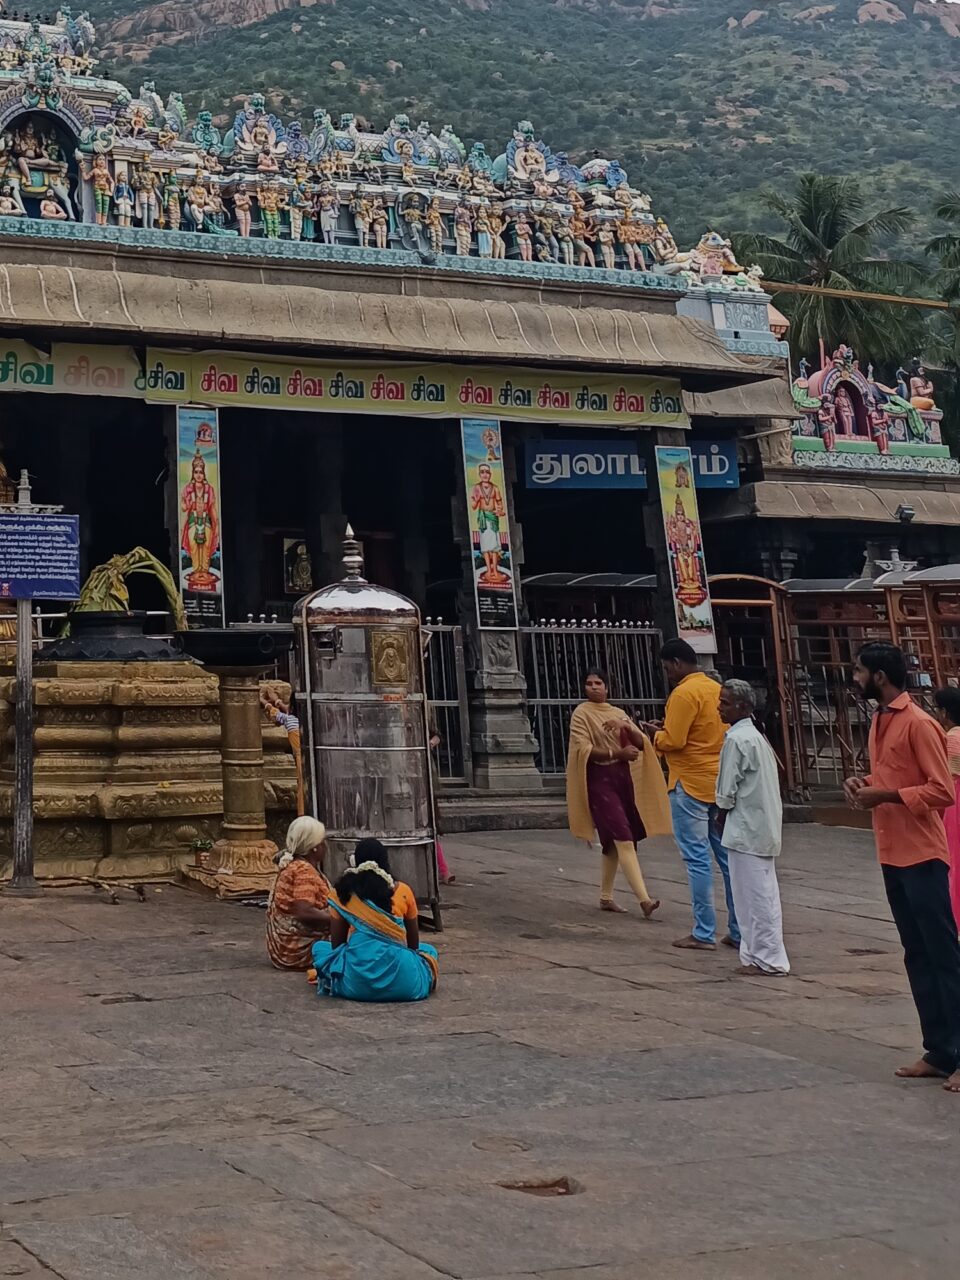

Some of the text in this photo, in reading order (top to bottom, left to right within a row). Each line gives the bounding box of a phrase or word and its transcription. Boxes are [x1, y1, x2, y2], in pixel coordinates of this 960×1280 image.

[63, 355, 125, 390] சிவ
[147, 362, 185, 390] சிவ
[200, 365, 445, 403] சிவ சிவ சிவ சிவ சிவ சிவ
[458, 378, 682, 414] சிவ சிவ சிவ சிவ சிவ சிவ
